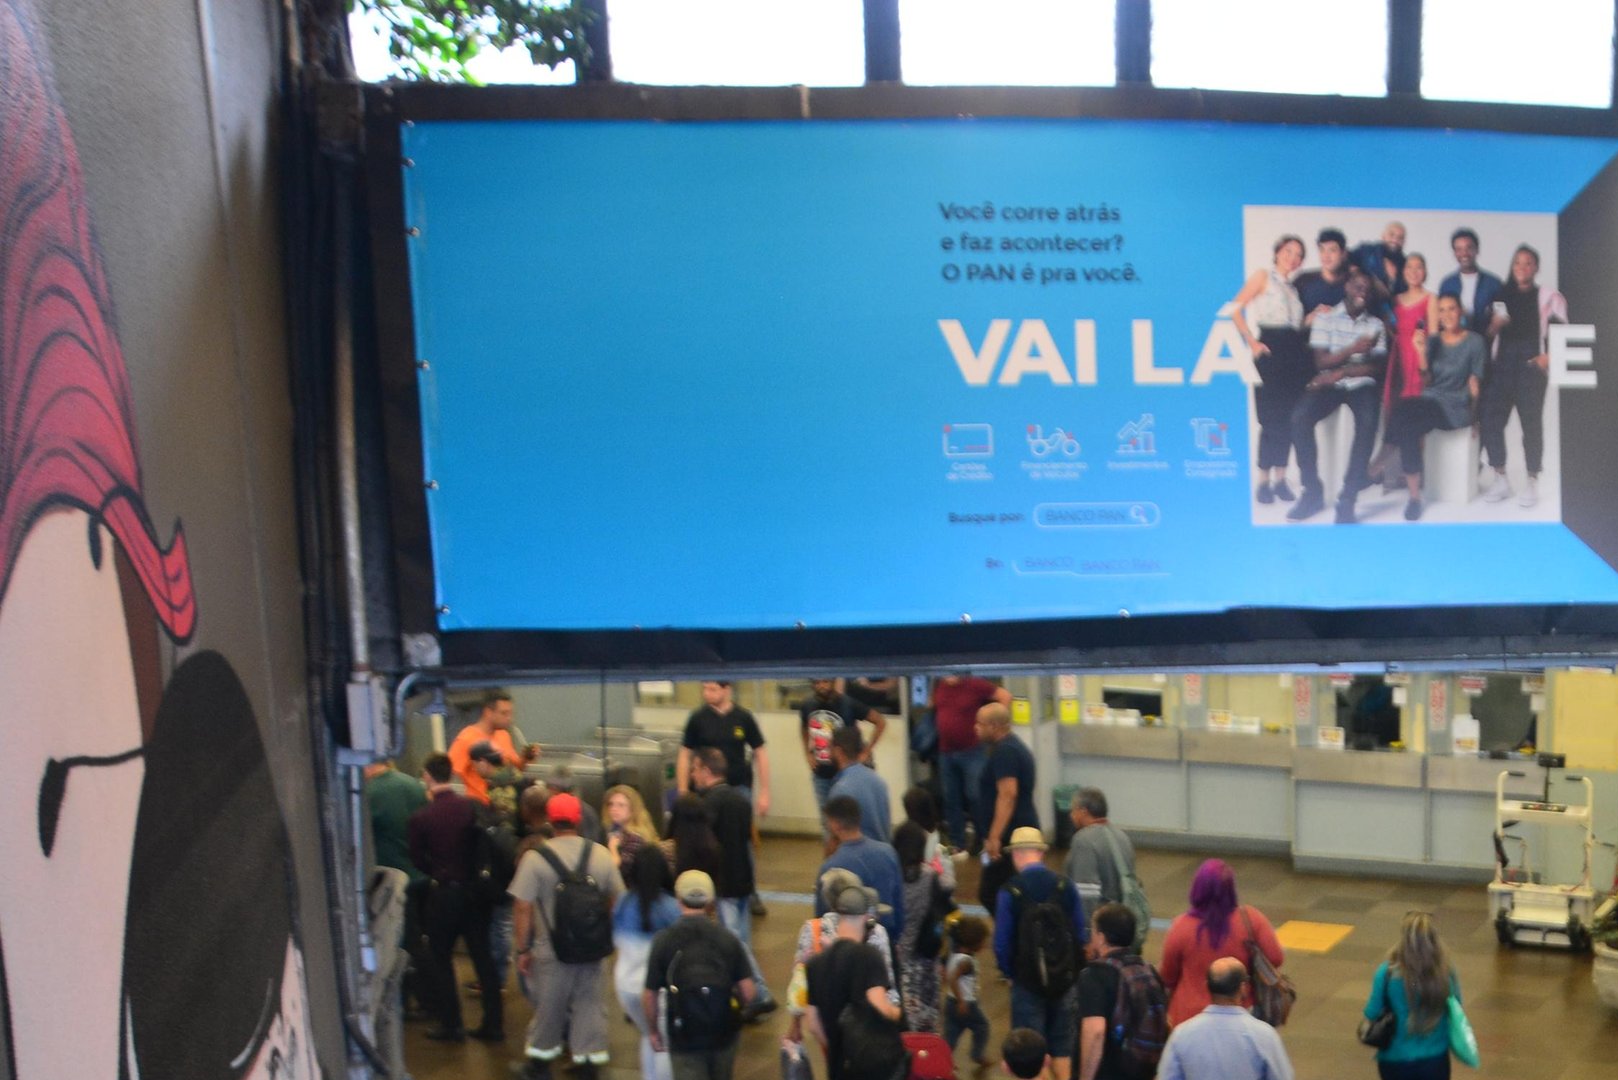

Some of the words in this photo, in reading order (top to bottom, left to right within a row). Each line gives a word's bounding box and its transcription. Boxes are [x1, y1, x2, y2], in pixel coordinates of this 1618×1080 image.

[938, 202, 994, 221] Você
[1002, 207, 1060, 221] corre
[1065, 202, 1121, 222] atrás
[941, 238, 955, 251] e
[960, 233, 993, 251] faz
[1000, 234, 1124, 252] acontecer?
[942, 264, 960, 282] O
[967, 264, 1015, 282] PAN
[1021, 263, 1034, 281] é
[1040, 267, 1077, 285] pra
[1082, 263, 1141, 282] você.
[937, 318, 1098, 386] VAI
[1548, 324, 1597, 388] E
[1045, 510, 1094, 522] BANCO
